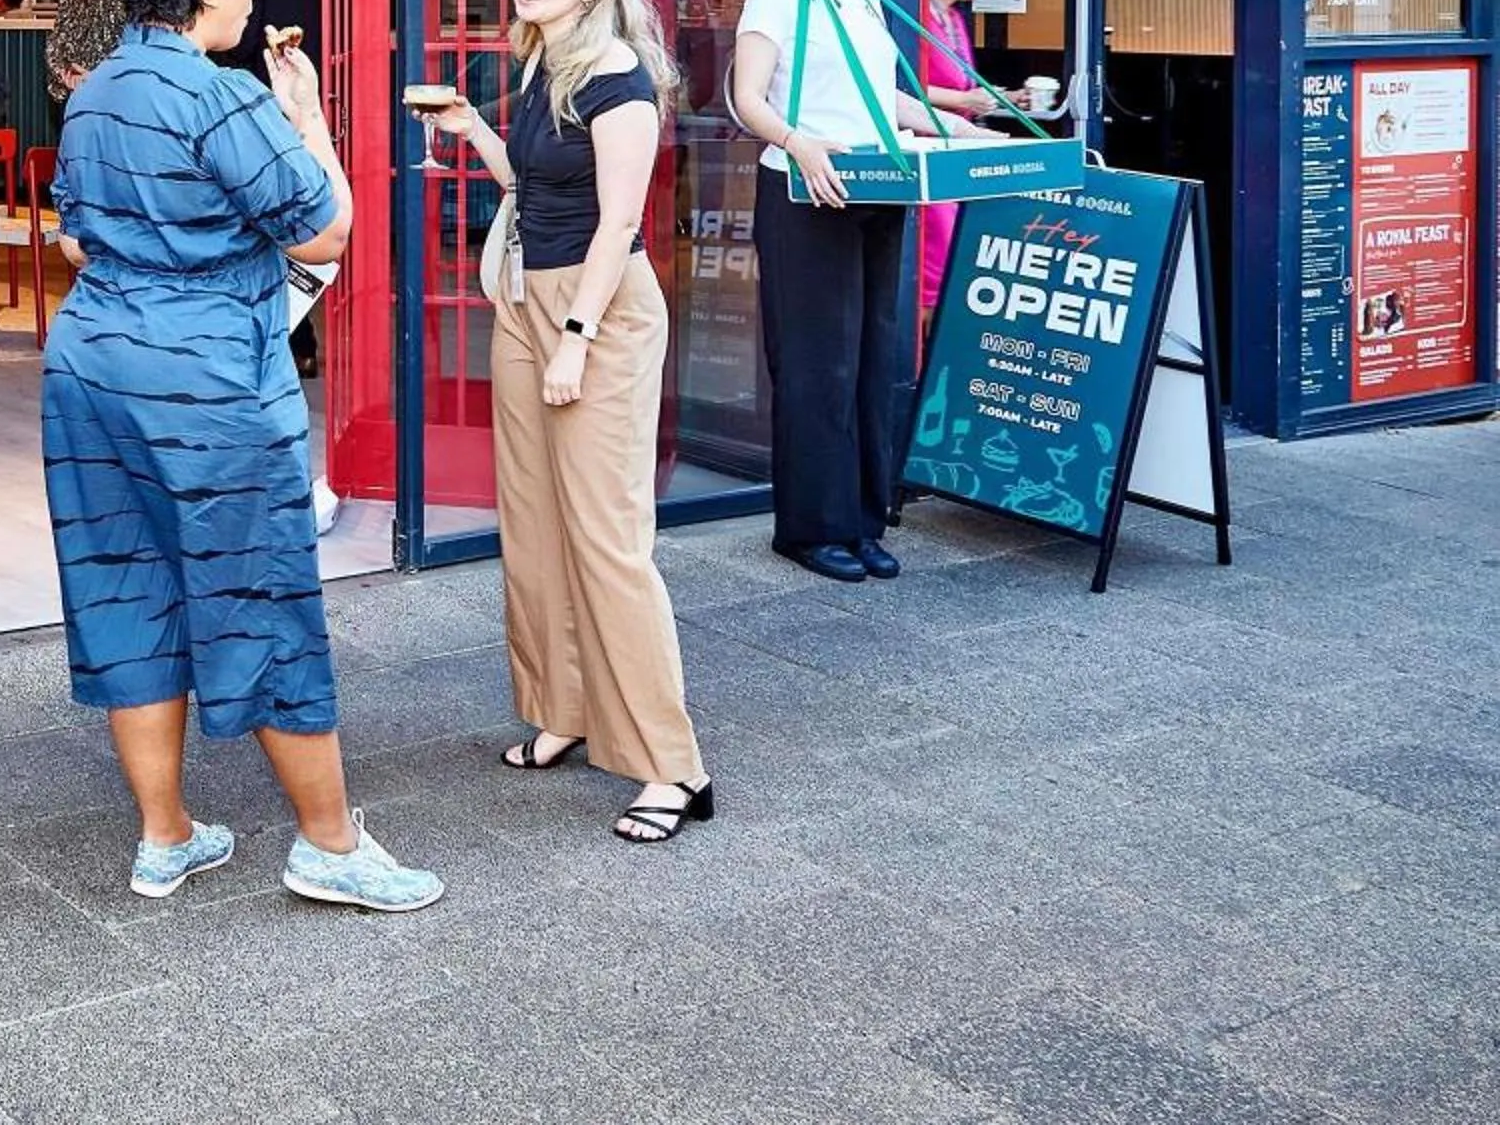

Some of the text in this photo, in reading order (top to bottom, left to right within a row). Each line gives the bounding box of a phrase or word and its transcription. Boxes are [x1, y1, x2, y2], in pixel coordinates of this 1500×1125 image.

[969, 165, 1011, 179] CHELSEA
[1075, 195, 1133, 216] SOCIAL
[1023, 214, 1100, 254] Hey
[975, 234, 1138, 297] WE'RE
[966, 276, 1129, 345] OPEN
[980, 332, 1035, 360] MON
[1050, 348, 1091, 374] FRI
[1041, 371, 1073, 386] LATE
[969, 378, 1014, 403] SAT
[1029, 393, 1081, 421] SUN
[1030, 417, 1062, 434] LATE
